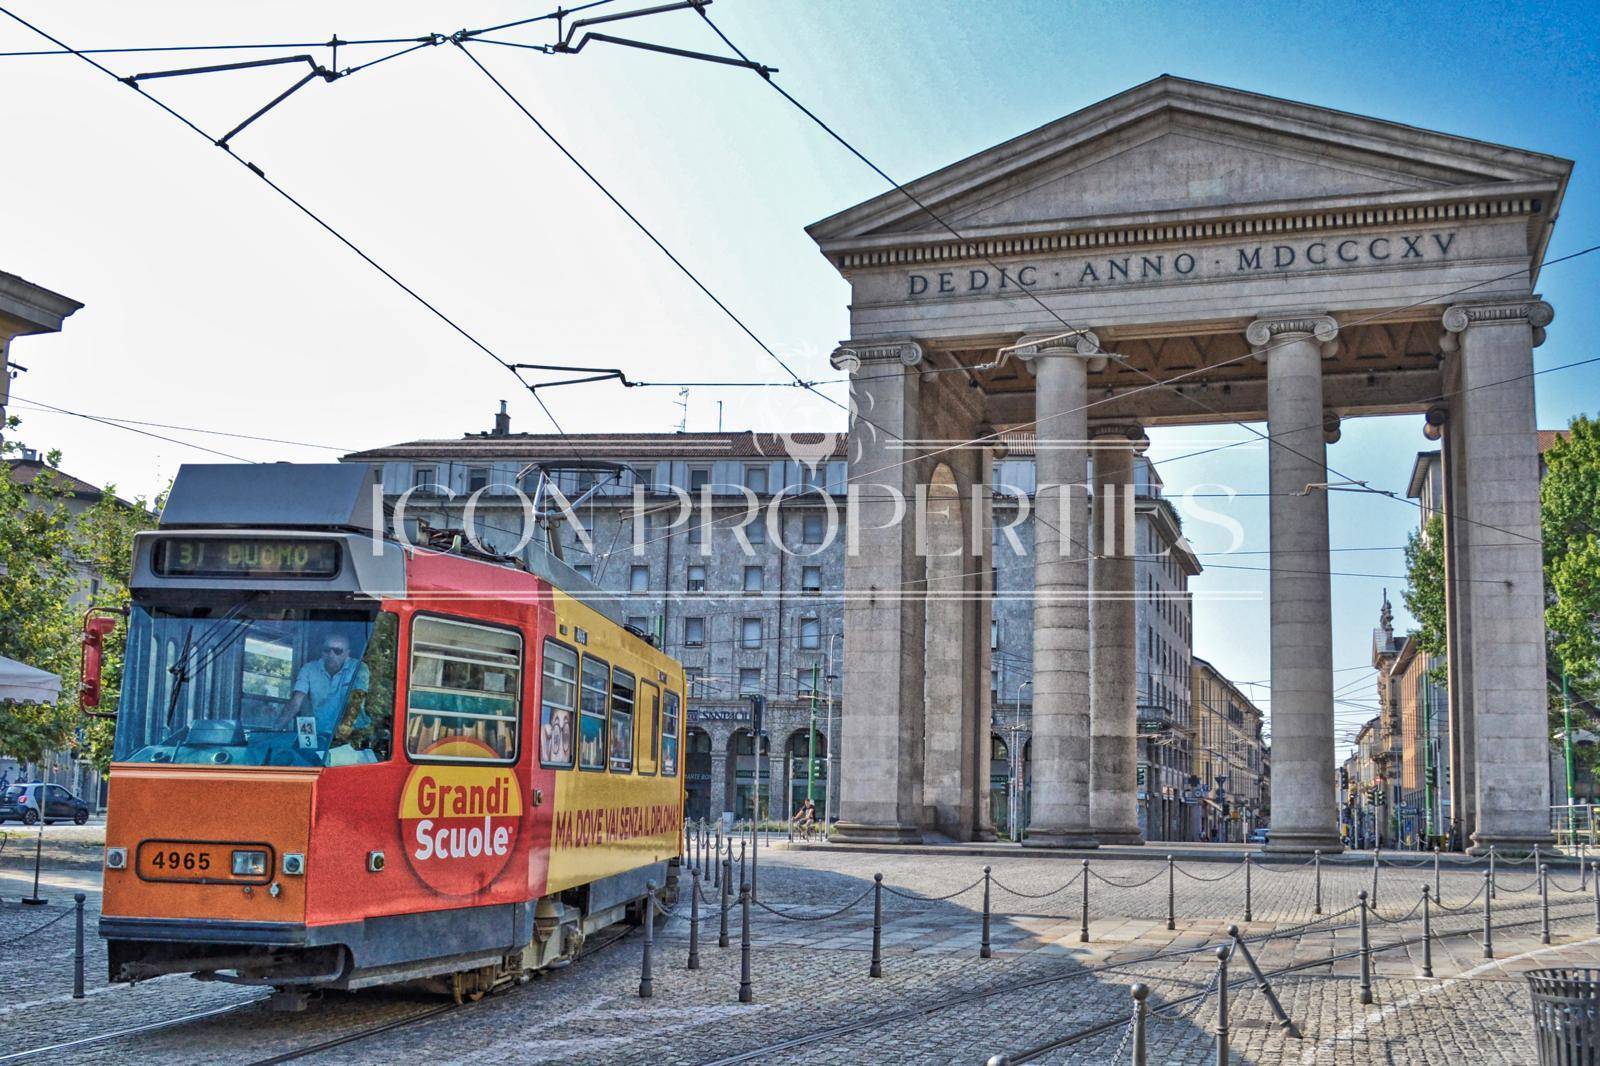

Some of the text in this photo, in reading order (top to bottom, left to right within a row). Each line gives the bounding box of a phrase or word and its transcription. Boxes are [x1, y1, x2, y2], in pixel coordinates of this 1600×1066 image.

[909, 233, 1456, 296] DEDIC ANNO MDCCCXV
[228, 543, 309, 566] DUOMO
[417, 776, 509, 818] Grandi
[414, 816, 509, 860] Scuole
[555, 810, 573, 852] MA
[575, 808, 604, 848] DOVE
[605, 807, 619, 845] VAI
[620, 806, 643, 840] SENZA
[152, 851, 210, 870] 4965
